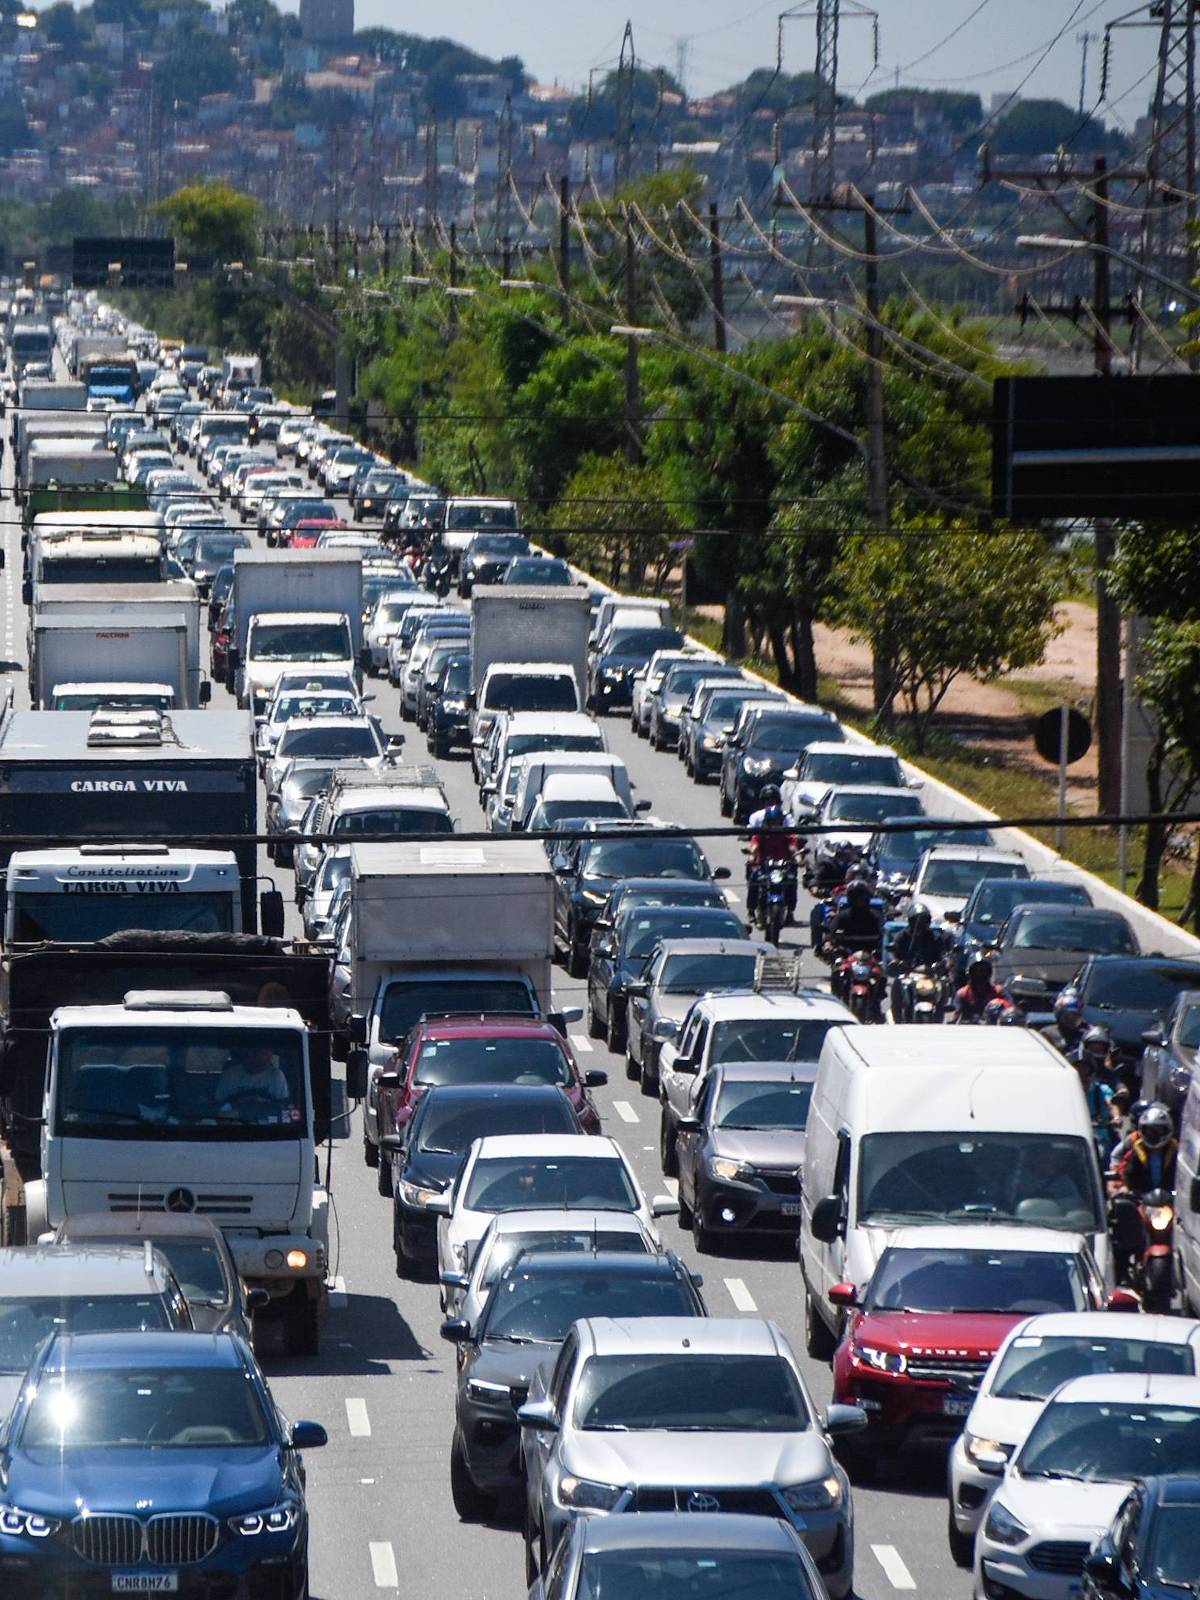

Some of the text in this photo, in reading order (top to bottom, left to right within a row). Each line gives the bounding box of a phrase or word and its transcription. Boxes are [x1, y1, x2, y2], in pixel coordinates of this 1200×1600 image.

[70, 780, 189, 792] CARGA VIVA
[67, 865, 179, 877] Constellation
[63, 881, 181, 893] CARGA VIVA
